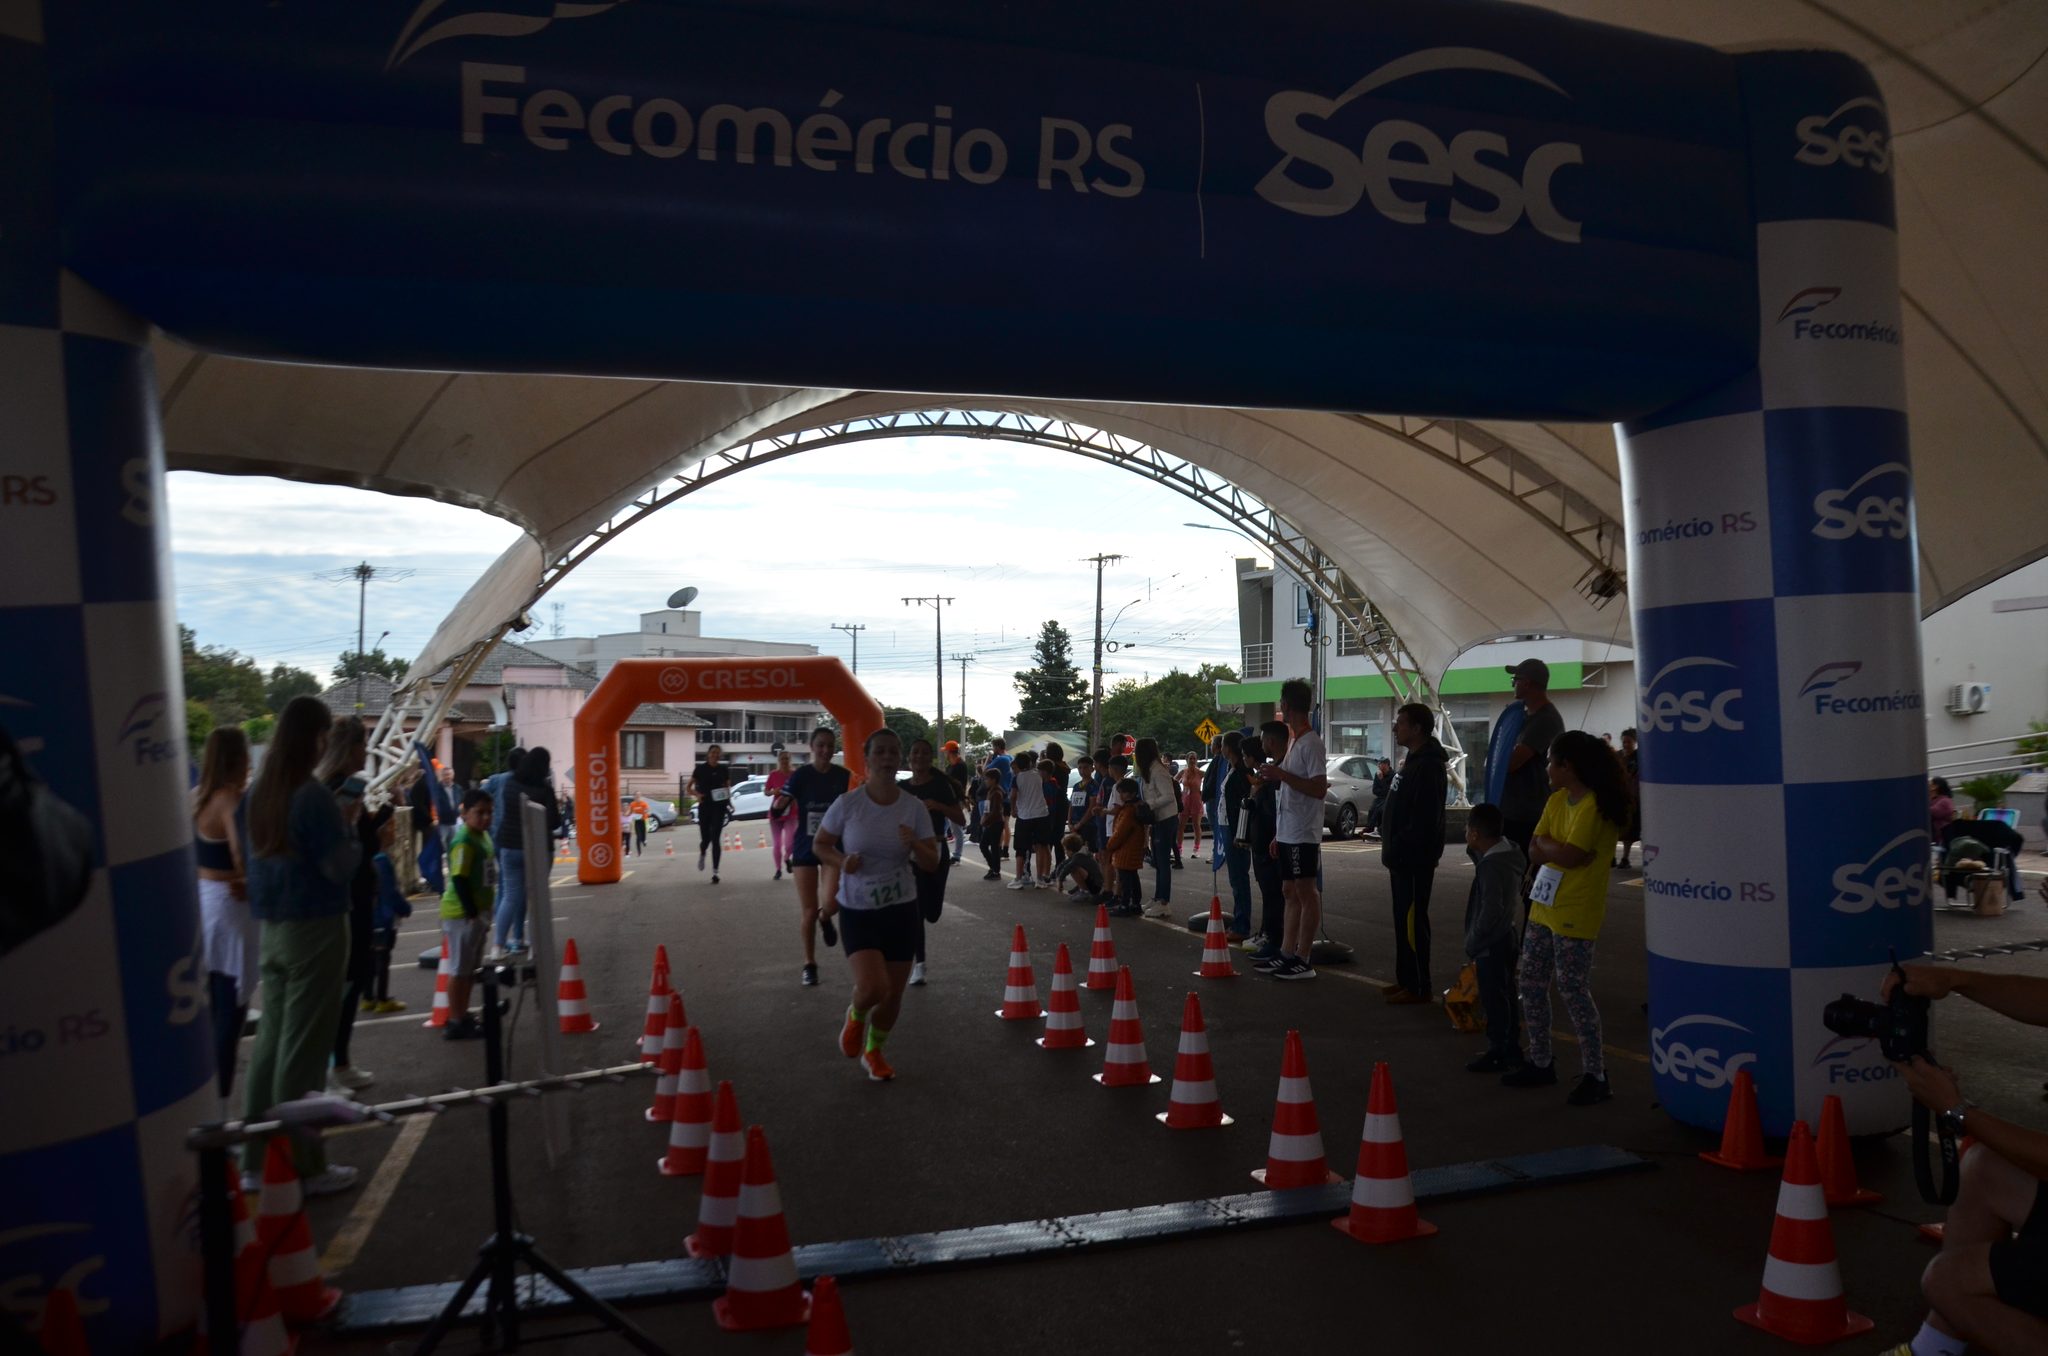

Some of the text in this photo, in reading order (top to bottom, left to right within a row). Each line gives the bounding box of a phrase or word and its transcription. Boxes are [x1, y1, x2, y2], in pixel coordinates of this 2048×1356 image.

[461, 60, 1147, 198] Fecomércio RS
[1721, 511, 1758, 534] RS
[1811, 488, 1912, 540] Ses
[698, 668, 804, 690] CRESOL
[588, 745, 609, 837] CRESOL
[871, 880, 902, 906] 121
[1740, 882, 1776, 902] RS
[1829, 862, 1931, 914] Ses
[58, 1010, 110, 1044] RS
